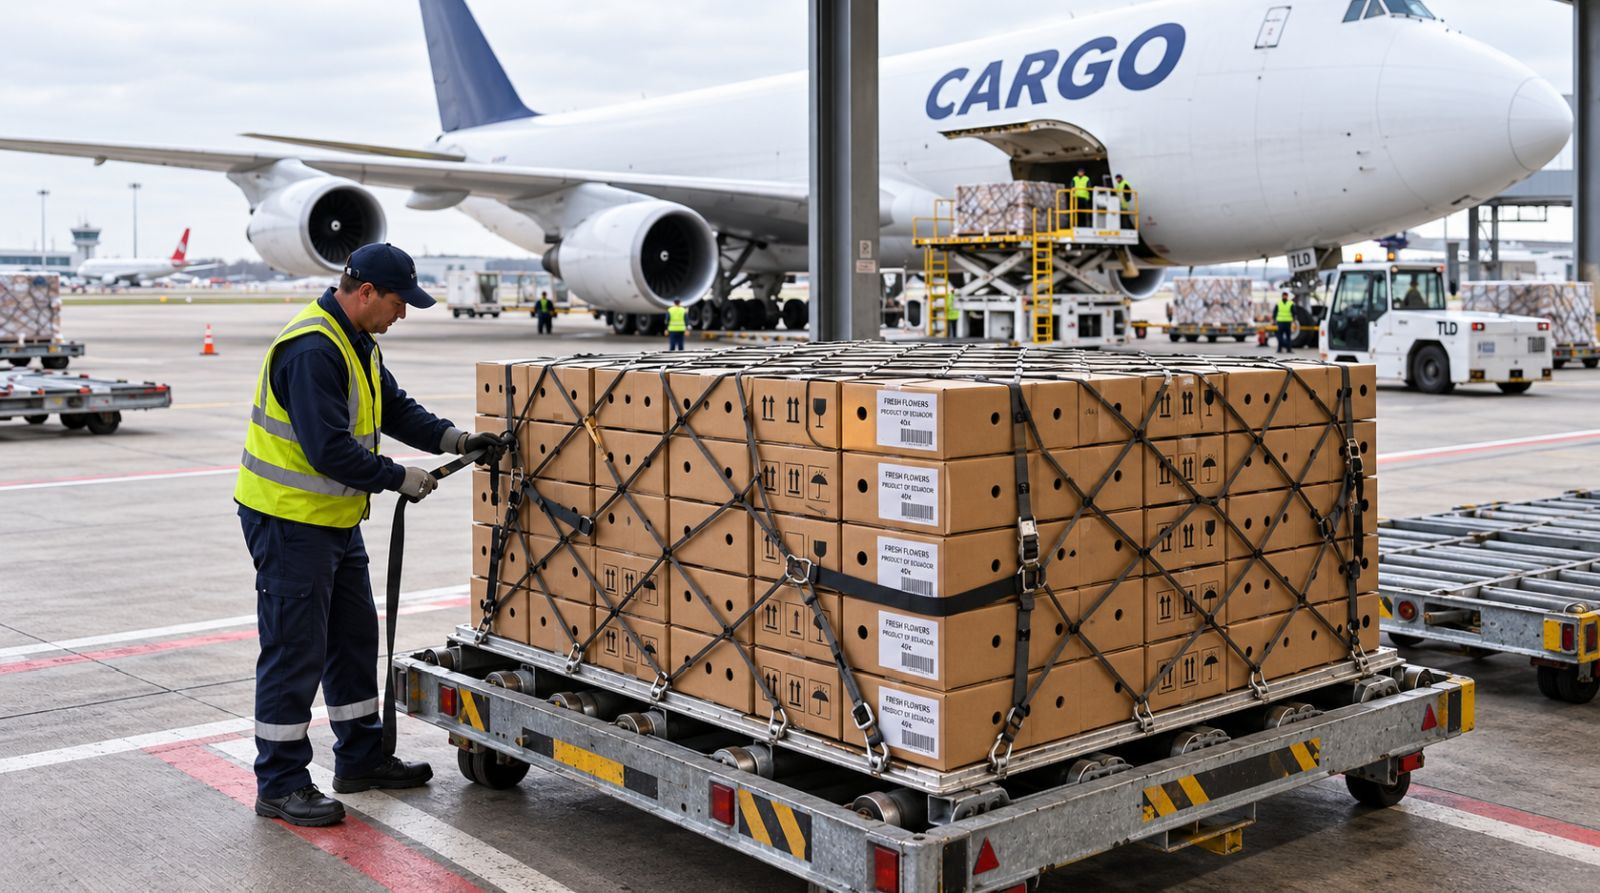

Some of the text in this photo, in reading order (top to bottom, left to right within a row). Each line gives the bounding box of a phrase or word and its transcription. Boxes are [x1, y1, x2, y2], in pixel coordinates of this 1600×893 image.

[926, 22, 1186, 120] CARGO
[1436, 321, 1458, 335] TLD
[884, 397, 929, 408] FRESH FLOWERS
[885, 471, 930, 483] FRESH FLOWERS
[885, 545, 929, 558] FRESH FLOWERS
[886, 619, 930, 635] FRESH FLOWERS
[886, 696, 930, 714] FRESH FLOWERS
